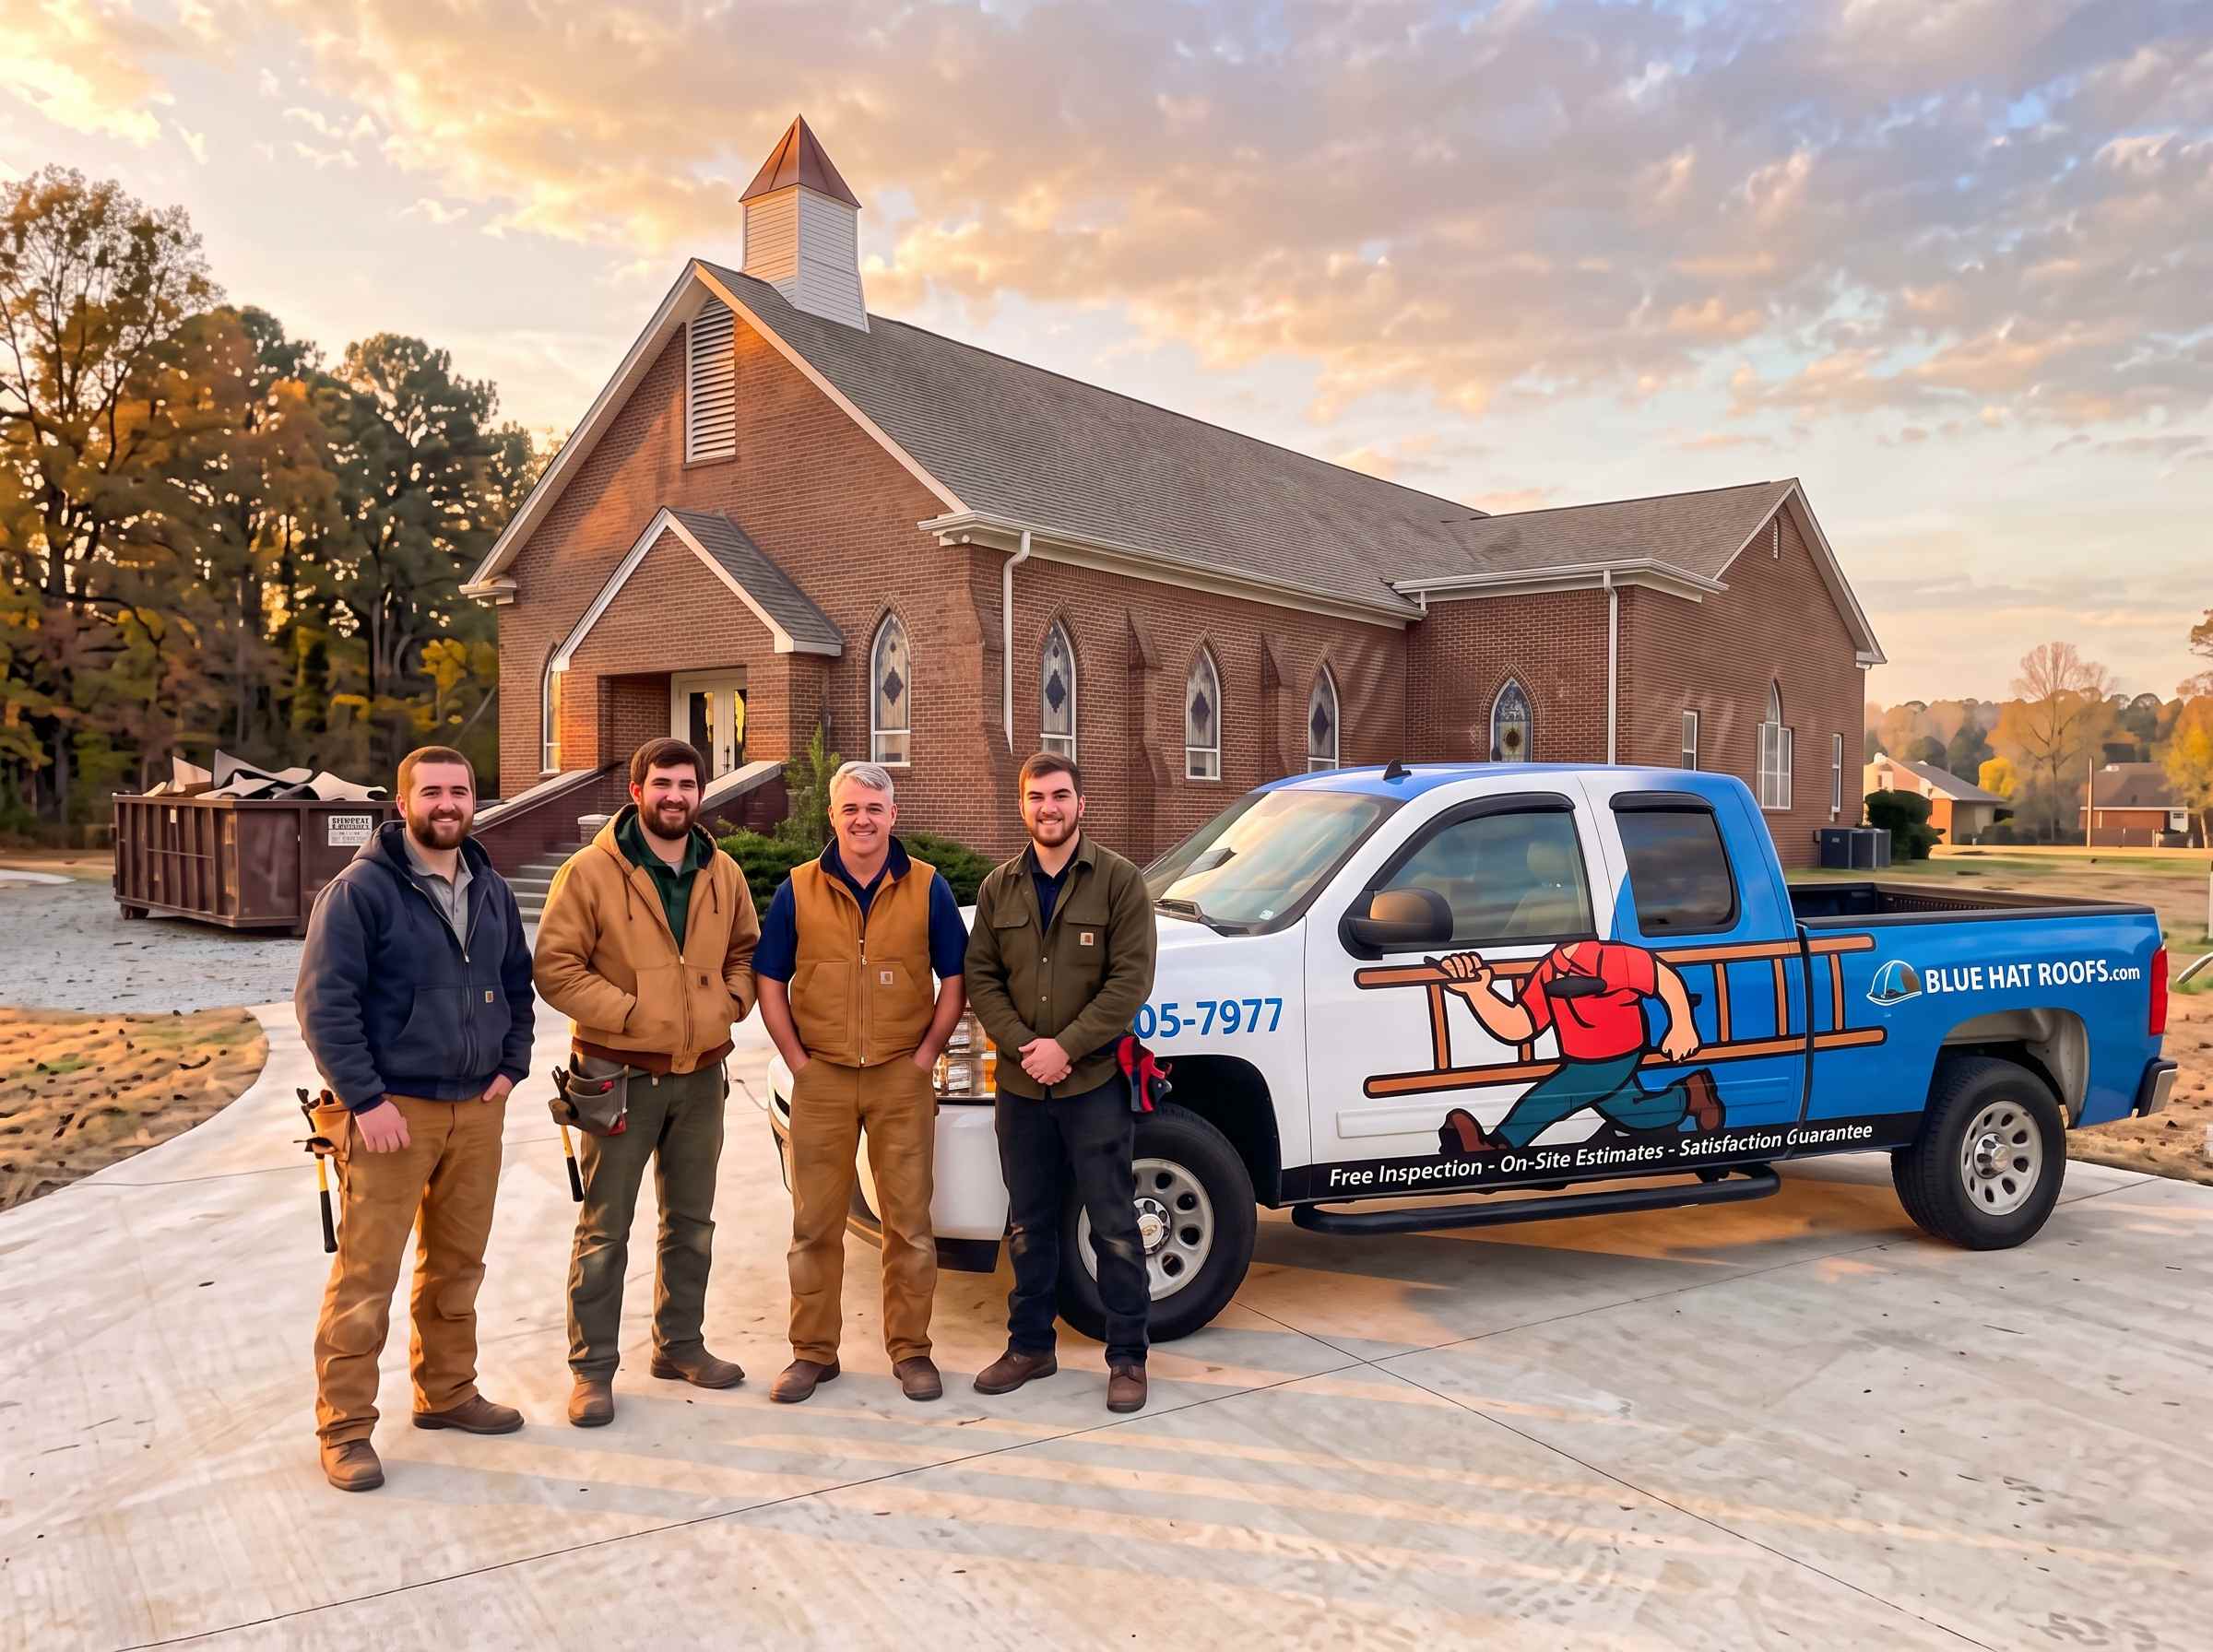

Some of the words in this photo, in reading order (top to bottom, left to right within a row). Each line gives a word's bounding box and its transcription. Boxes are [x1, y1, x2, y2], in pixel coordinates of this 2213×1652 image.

[1925, 968, 1983, 994] BLUE
[1989, 964, 2032, 989] HAT
[2038, 960, 2140, 986] ROOFS.com
[1330, 1168, 1373, 1186] Free
[1379, 1159, 1482, 1185] Inspection
[1500, 1150, 1570, 1173] On-Site
[1576, 1143, 1663, 1166] Estimates
[1679, 1131, 1781, 1157] Satisfaction
[1786, 1123, 1873, 1146] Guarantee
